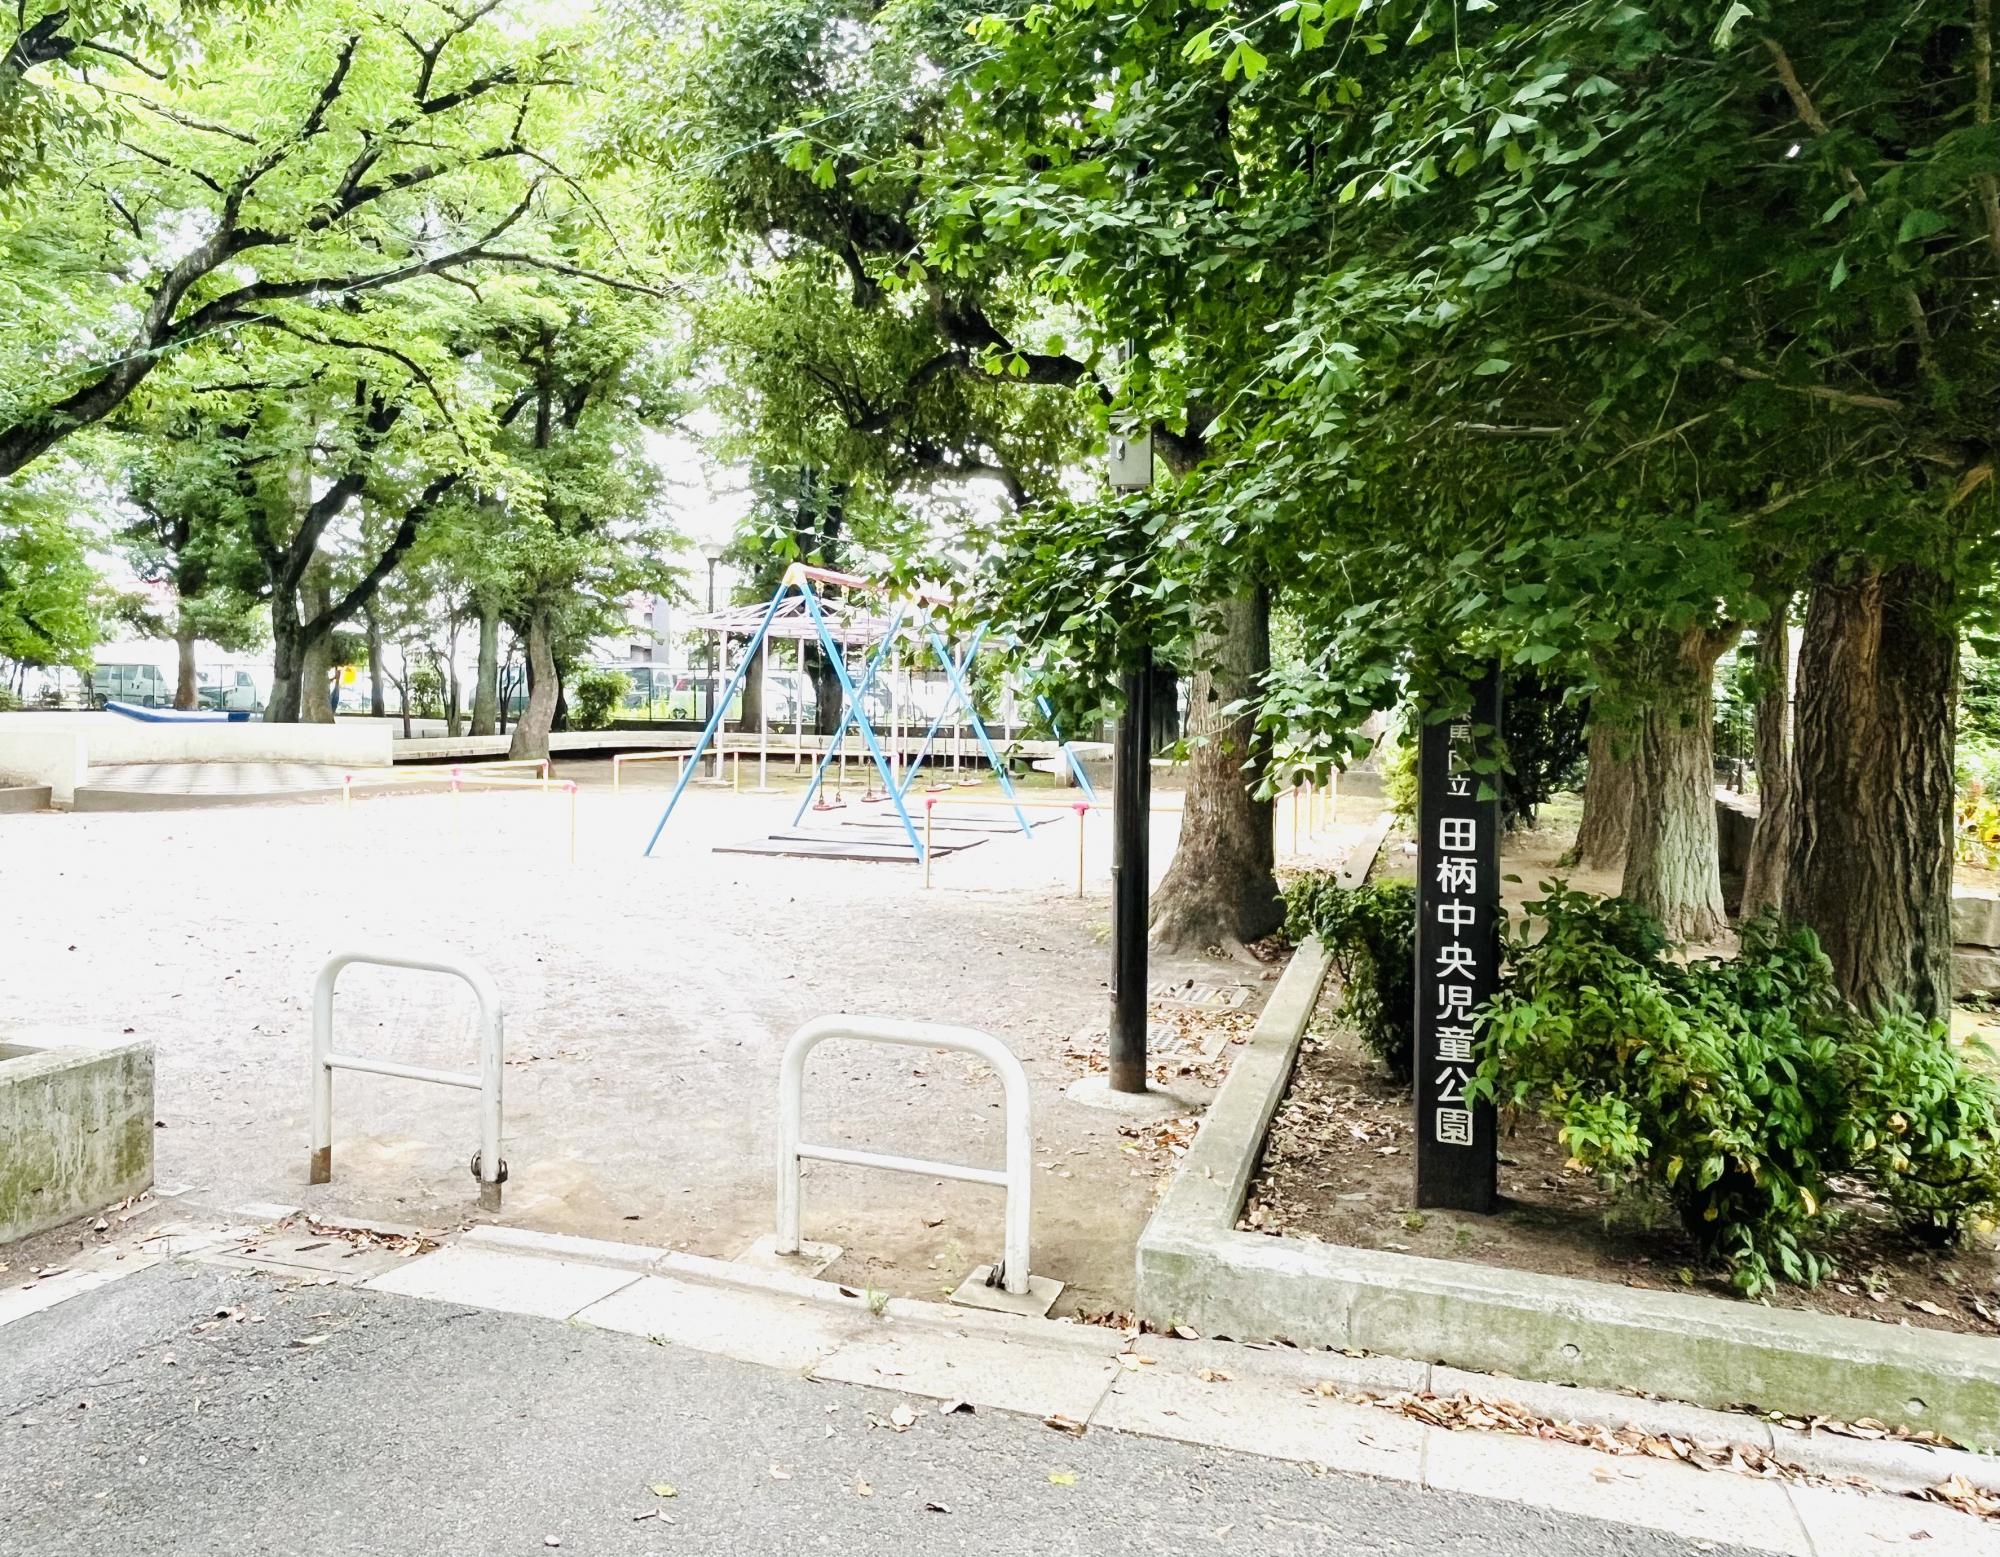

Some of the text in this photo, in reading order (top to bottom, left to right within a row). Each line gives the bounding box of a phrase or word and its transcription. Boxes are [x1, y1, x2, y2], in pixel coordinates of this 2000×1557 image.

[1435, 817, 1477, 1146] 田柄中央児童公園
